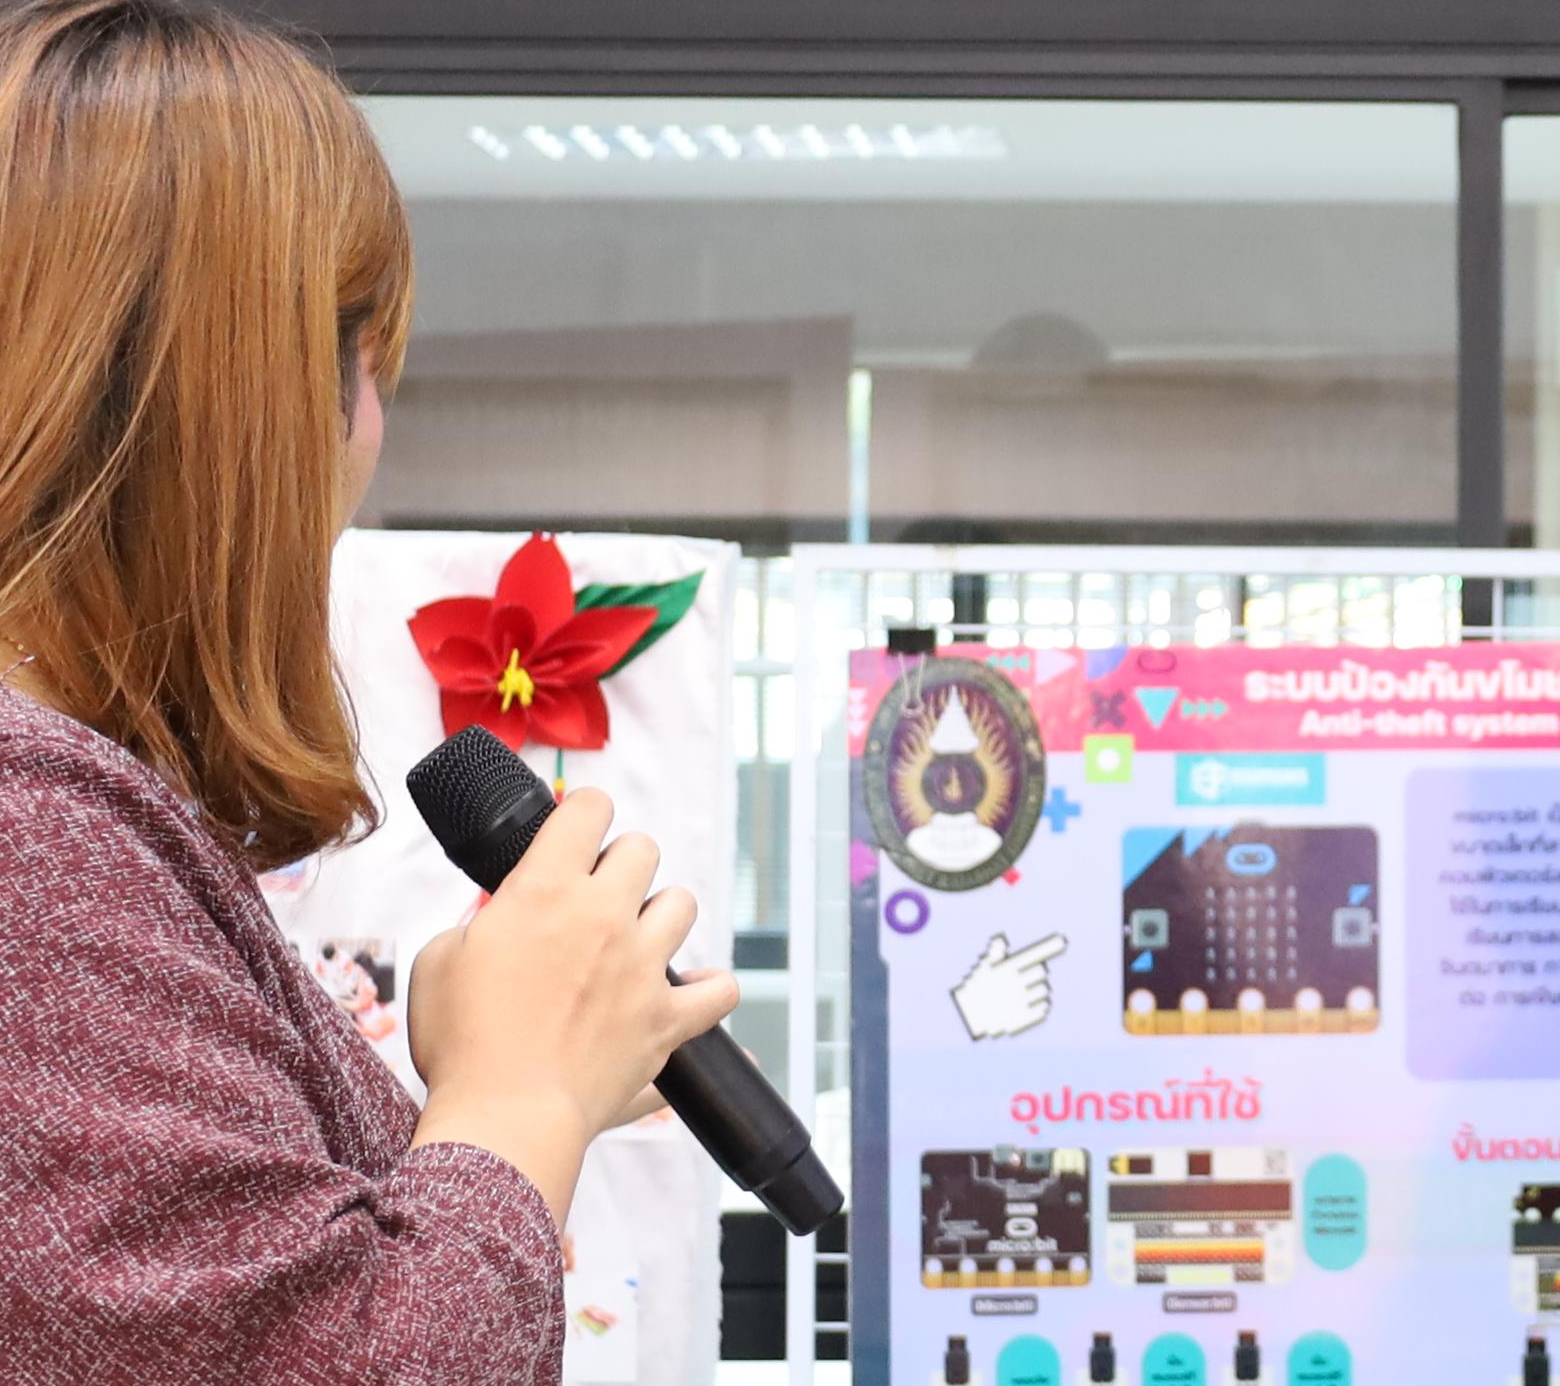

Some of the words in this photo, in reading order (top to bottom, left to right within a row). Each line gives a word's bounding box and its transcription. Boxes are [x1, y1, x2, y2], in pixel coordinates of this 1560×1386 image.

[1010, 1066, 1263, 1136] อุปกรณ์ที่ใช้
